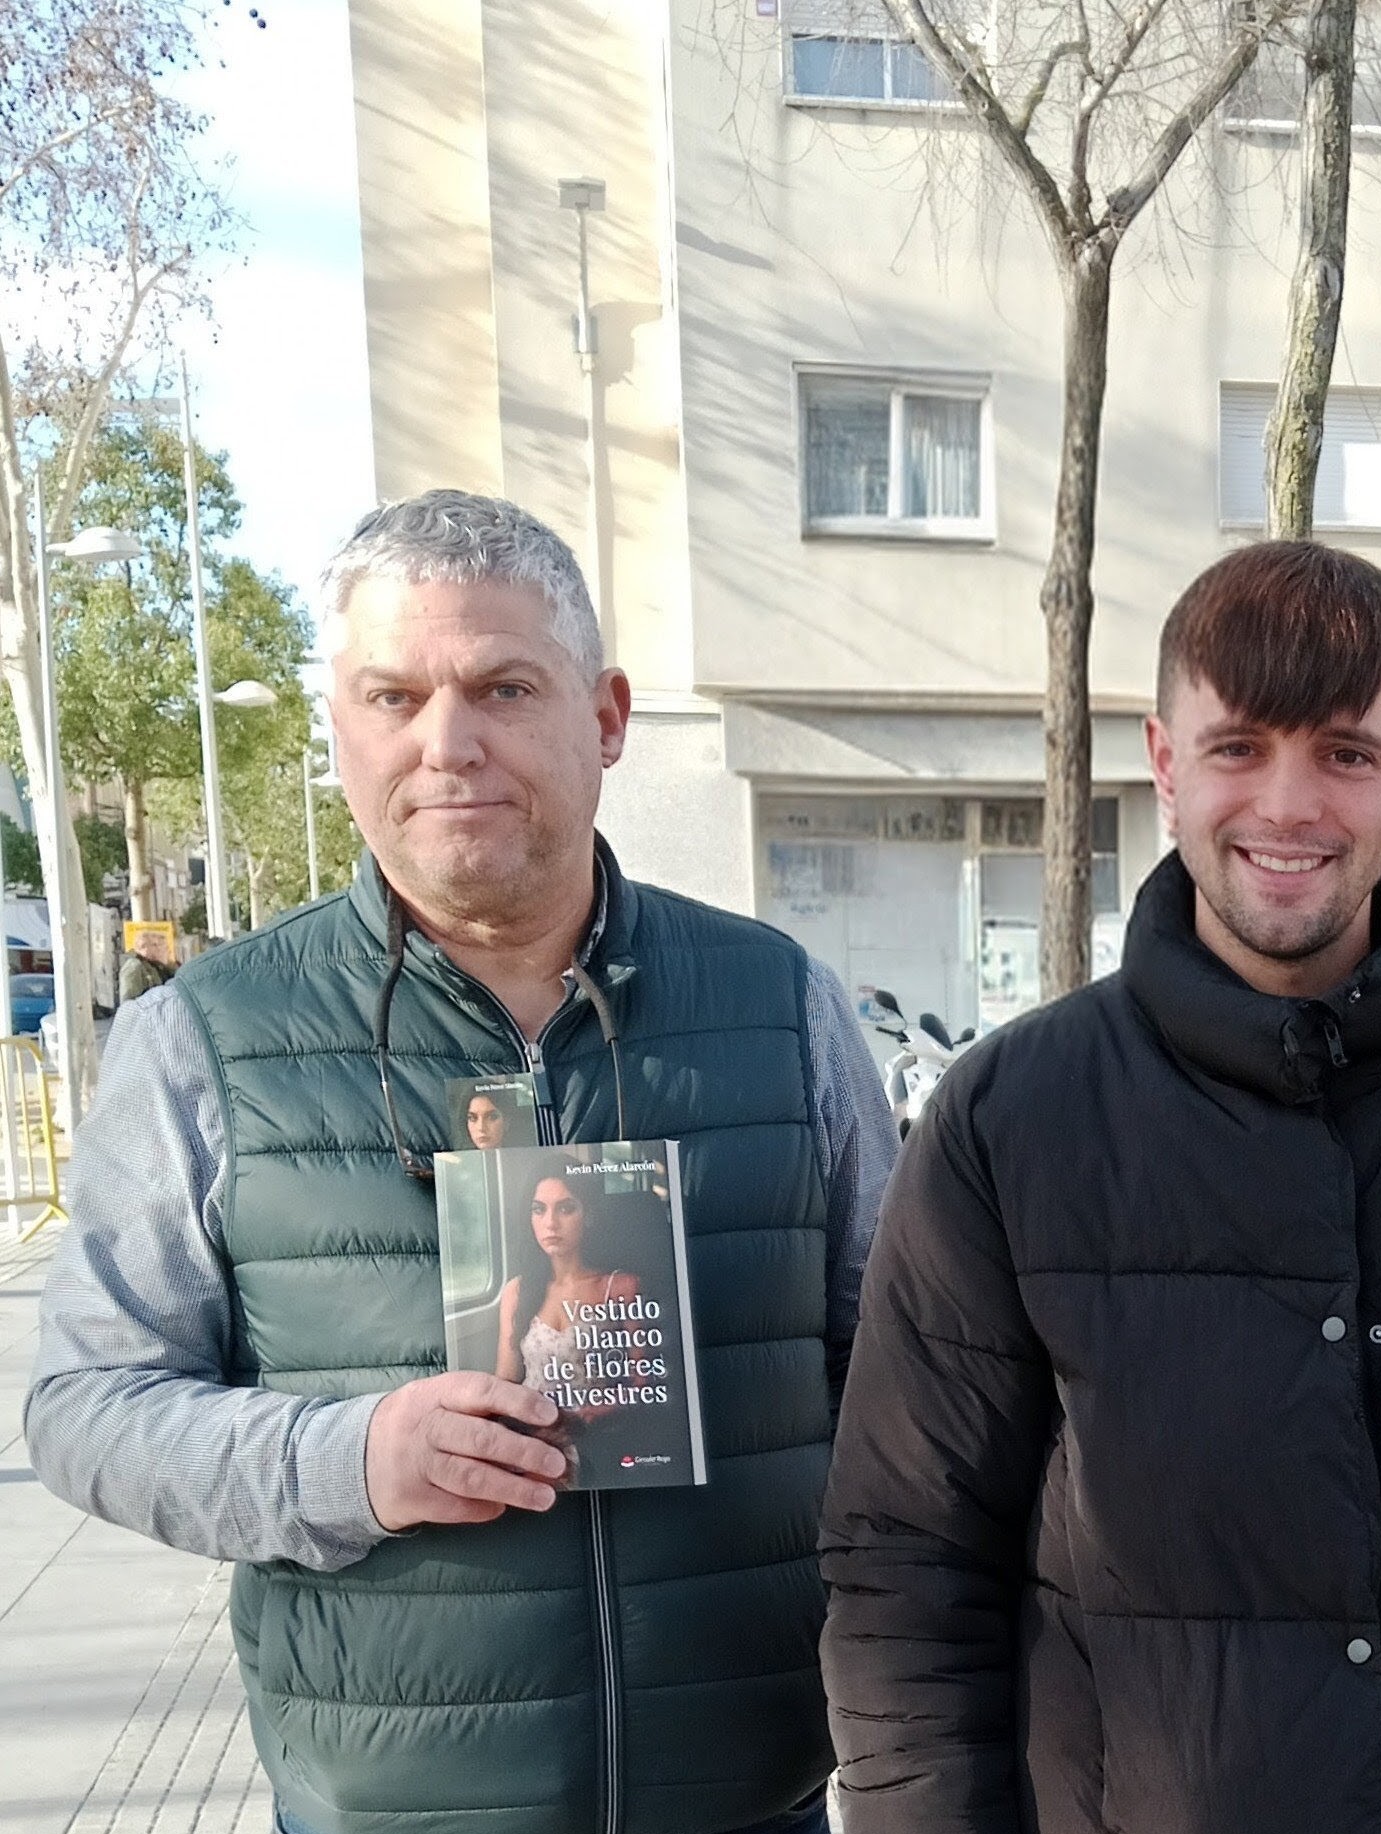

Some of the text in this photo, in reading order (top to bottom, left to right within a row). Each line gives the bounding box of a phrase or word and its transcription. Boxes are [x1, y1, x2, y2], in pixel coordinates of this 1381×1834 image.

[566, 1160, 656, 1175] Kevin Pérez Alarcón
[562, 1294, 661, 1323] Vestido
[574, 1325, 663, 1350] blanco
[543, 1352, 667, 1382] de flores
